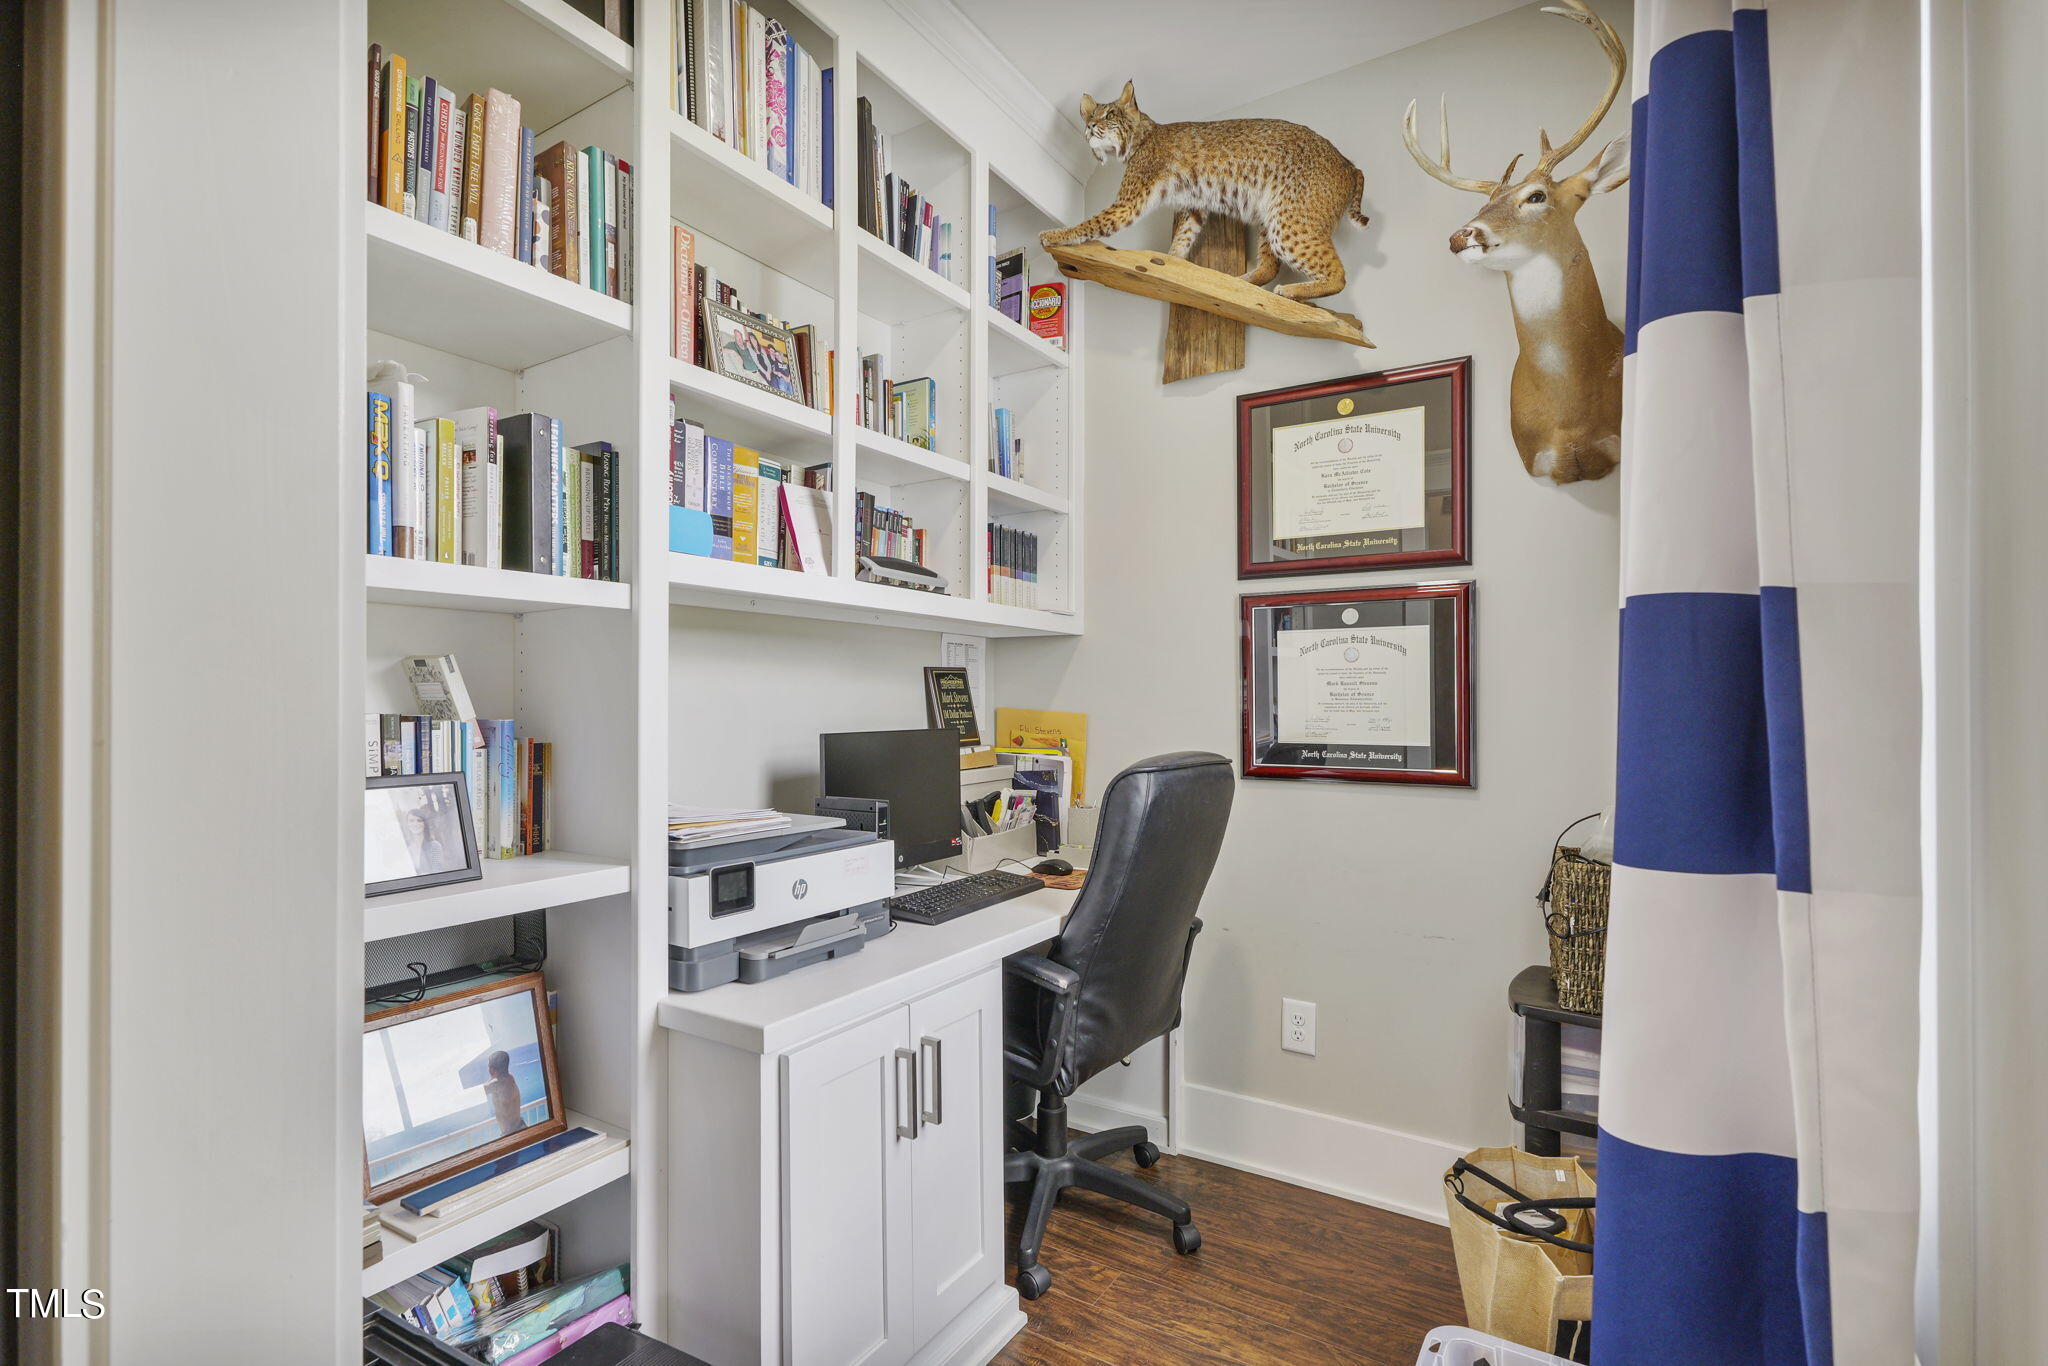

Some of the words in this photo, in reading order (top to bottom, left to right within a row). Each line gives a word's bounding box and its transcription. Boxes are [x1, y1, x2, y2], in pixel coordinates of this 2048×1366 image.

[440, 102, 449, 132] CHRIST
[456, 114, 464, 127] THE
[407, 130, 415, 158] PASTOR'S
[454, 131, 464, 162] WOUNDED
[452, 168, 462, 198] WARRIOR
[470, 161, 481, 182] FREE
[567, 160, 576, 184] KINGS
[470, 184, 480, 206] WILL
[567, 189, 576, 221] QUEENS
[679, 232, 691, 295] Dictionary
[681, 309, 692, 359] Children
[1294, 436, 1314, 452] North
[1314, 428, 1343, 442] Carolina
[1345, 424, 1363, 434] State
[1364, 423, 1402, 441] University
[1296, 542, 1314, 553] North
[1315, 541, 1342, 550] Carolina
[1343, 540, 1362, 548] State
[1363, 537, 1398, 547] University
[1299, 641, 1319, 656] North
[1320, 635, 1348, 648] Carolina
[1350, 634, 1368, 644] State
[1370, 634, 1407, 656] University
[1301, 749, 1320, 760] North
[1322, 750, 1348, 759] Carolina
[1348, 750, 1367, 760] State
[1368, 751, 1402, 762] University
[792, 878, 808, 900] hp
